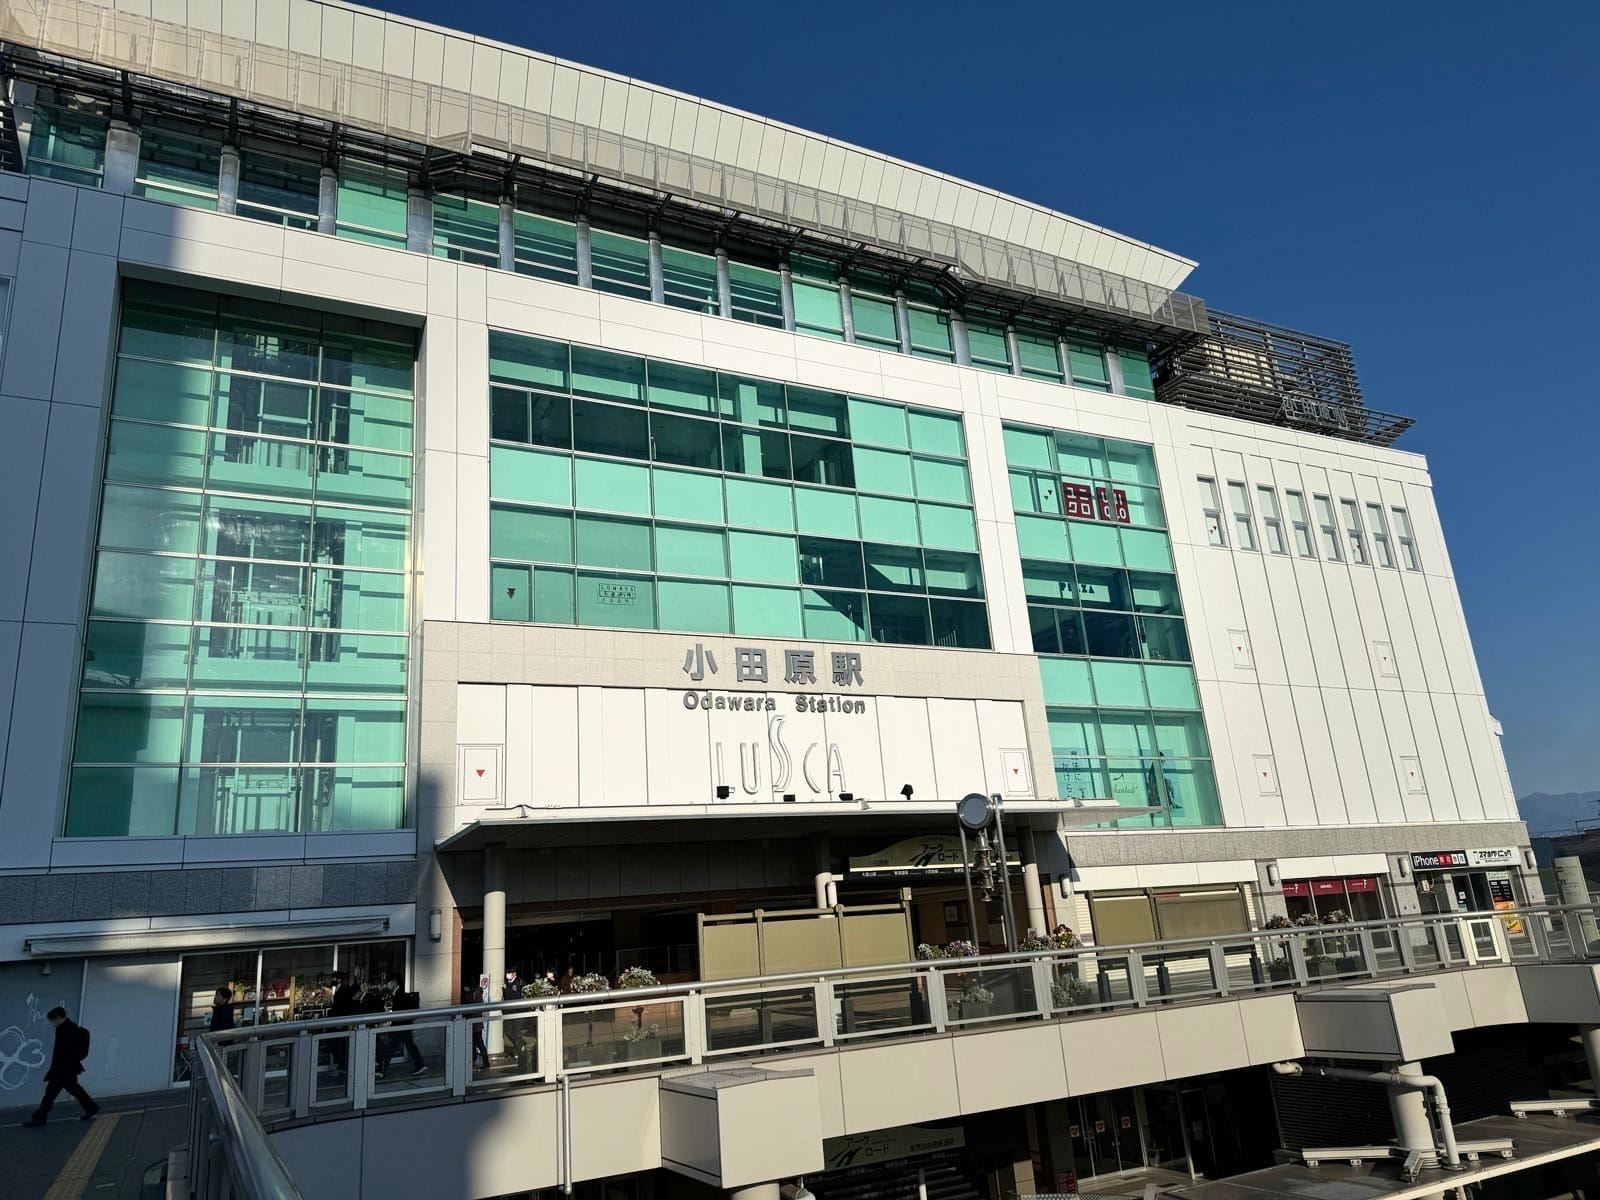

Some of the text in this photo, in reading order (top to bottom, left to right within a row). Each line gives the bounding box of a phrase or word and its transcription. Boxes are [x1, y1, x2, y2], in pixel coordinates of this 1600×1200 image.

[682, 643, 864, 687] 小田原駅
[683, 691, 866, 714] Odawara Station
[716, 714, 847, 795] LUSCA
[1412, 855, 1440, 867] iPhone
